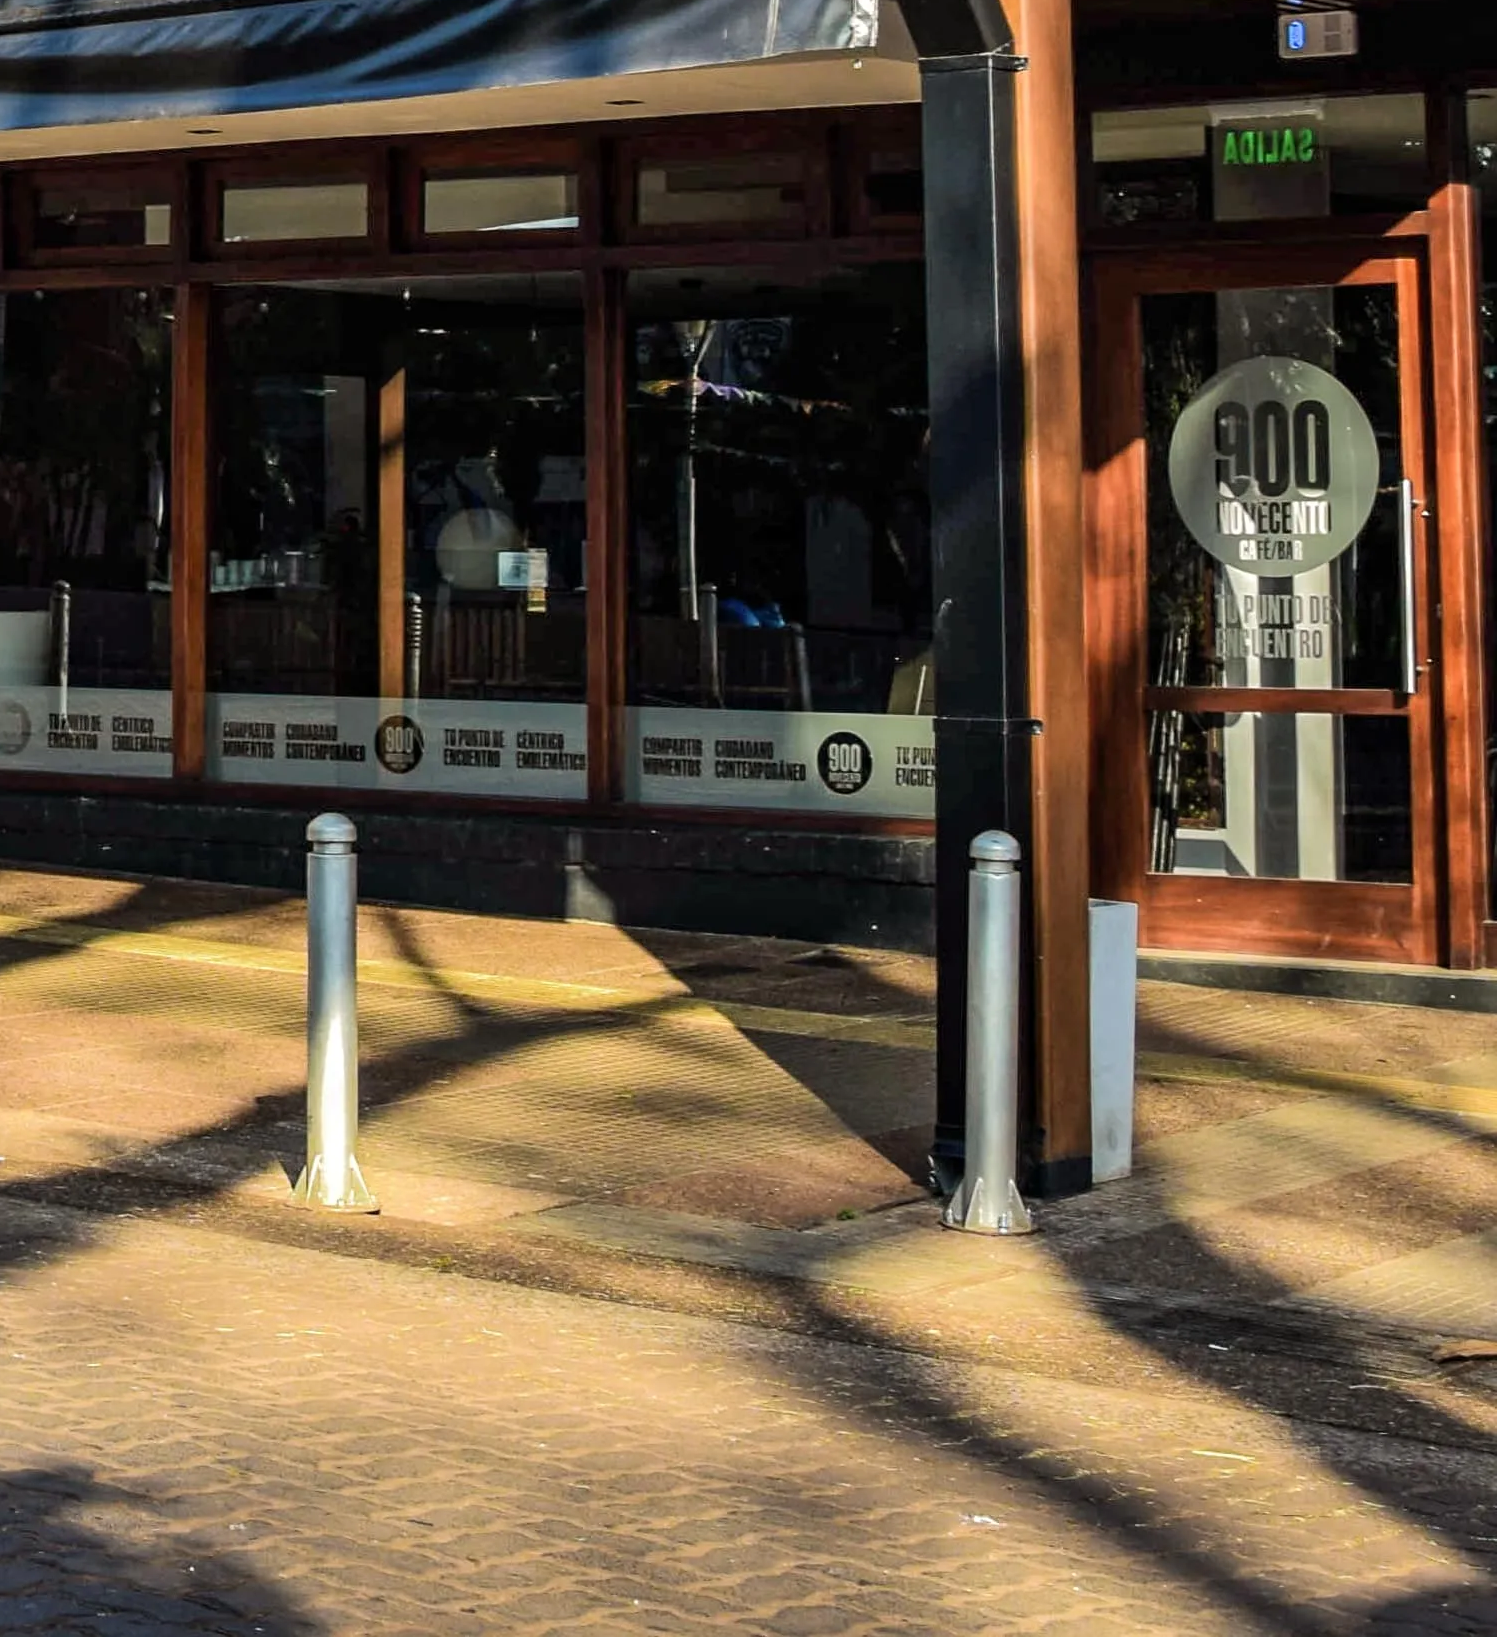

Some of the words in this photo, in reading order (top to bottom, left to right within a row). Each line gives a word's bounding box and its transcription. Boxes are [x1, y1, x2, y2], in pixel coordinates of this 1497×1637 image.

[1214, 400, 1330, 498] 900
[1217, 501, 1332, 534] NOVECENTO
[1239, 537, 1303, 561] CAFÉ/BAR
[1215, 594, 1239, 624] TU
[1244, 594, 1304, 624] PUNTO
[1310, 595, 1333, 625] DE
[1215, 628, 1324, 659] ENCUENTRO
[385, 726, 413, 753] 900
[829, 743, 862, 772] 900
[896, 746, 910, 765] TU
[913, 747, 936, 766] PUN
[895, 767, 935, 787] ENCUE
